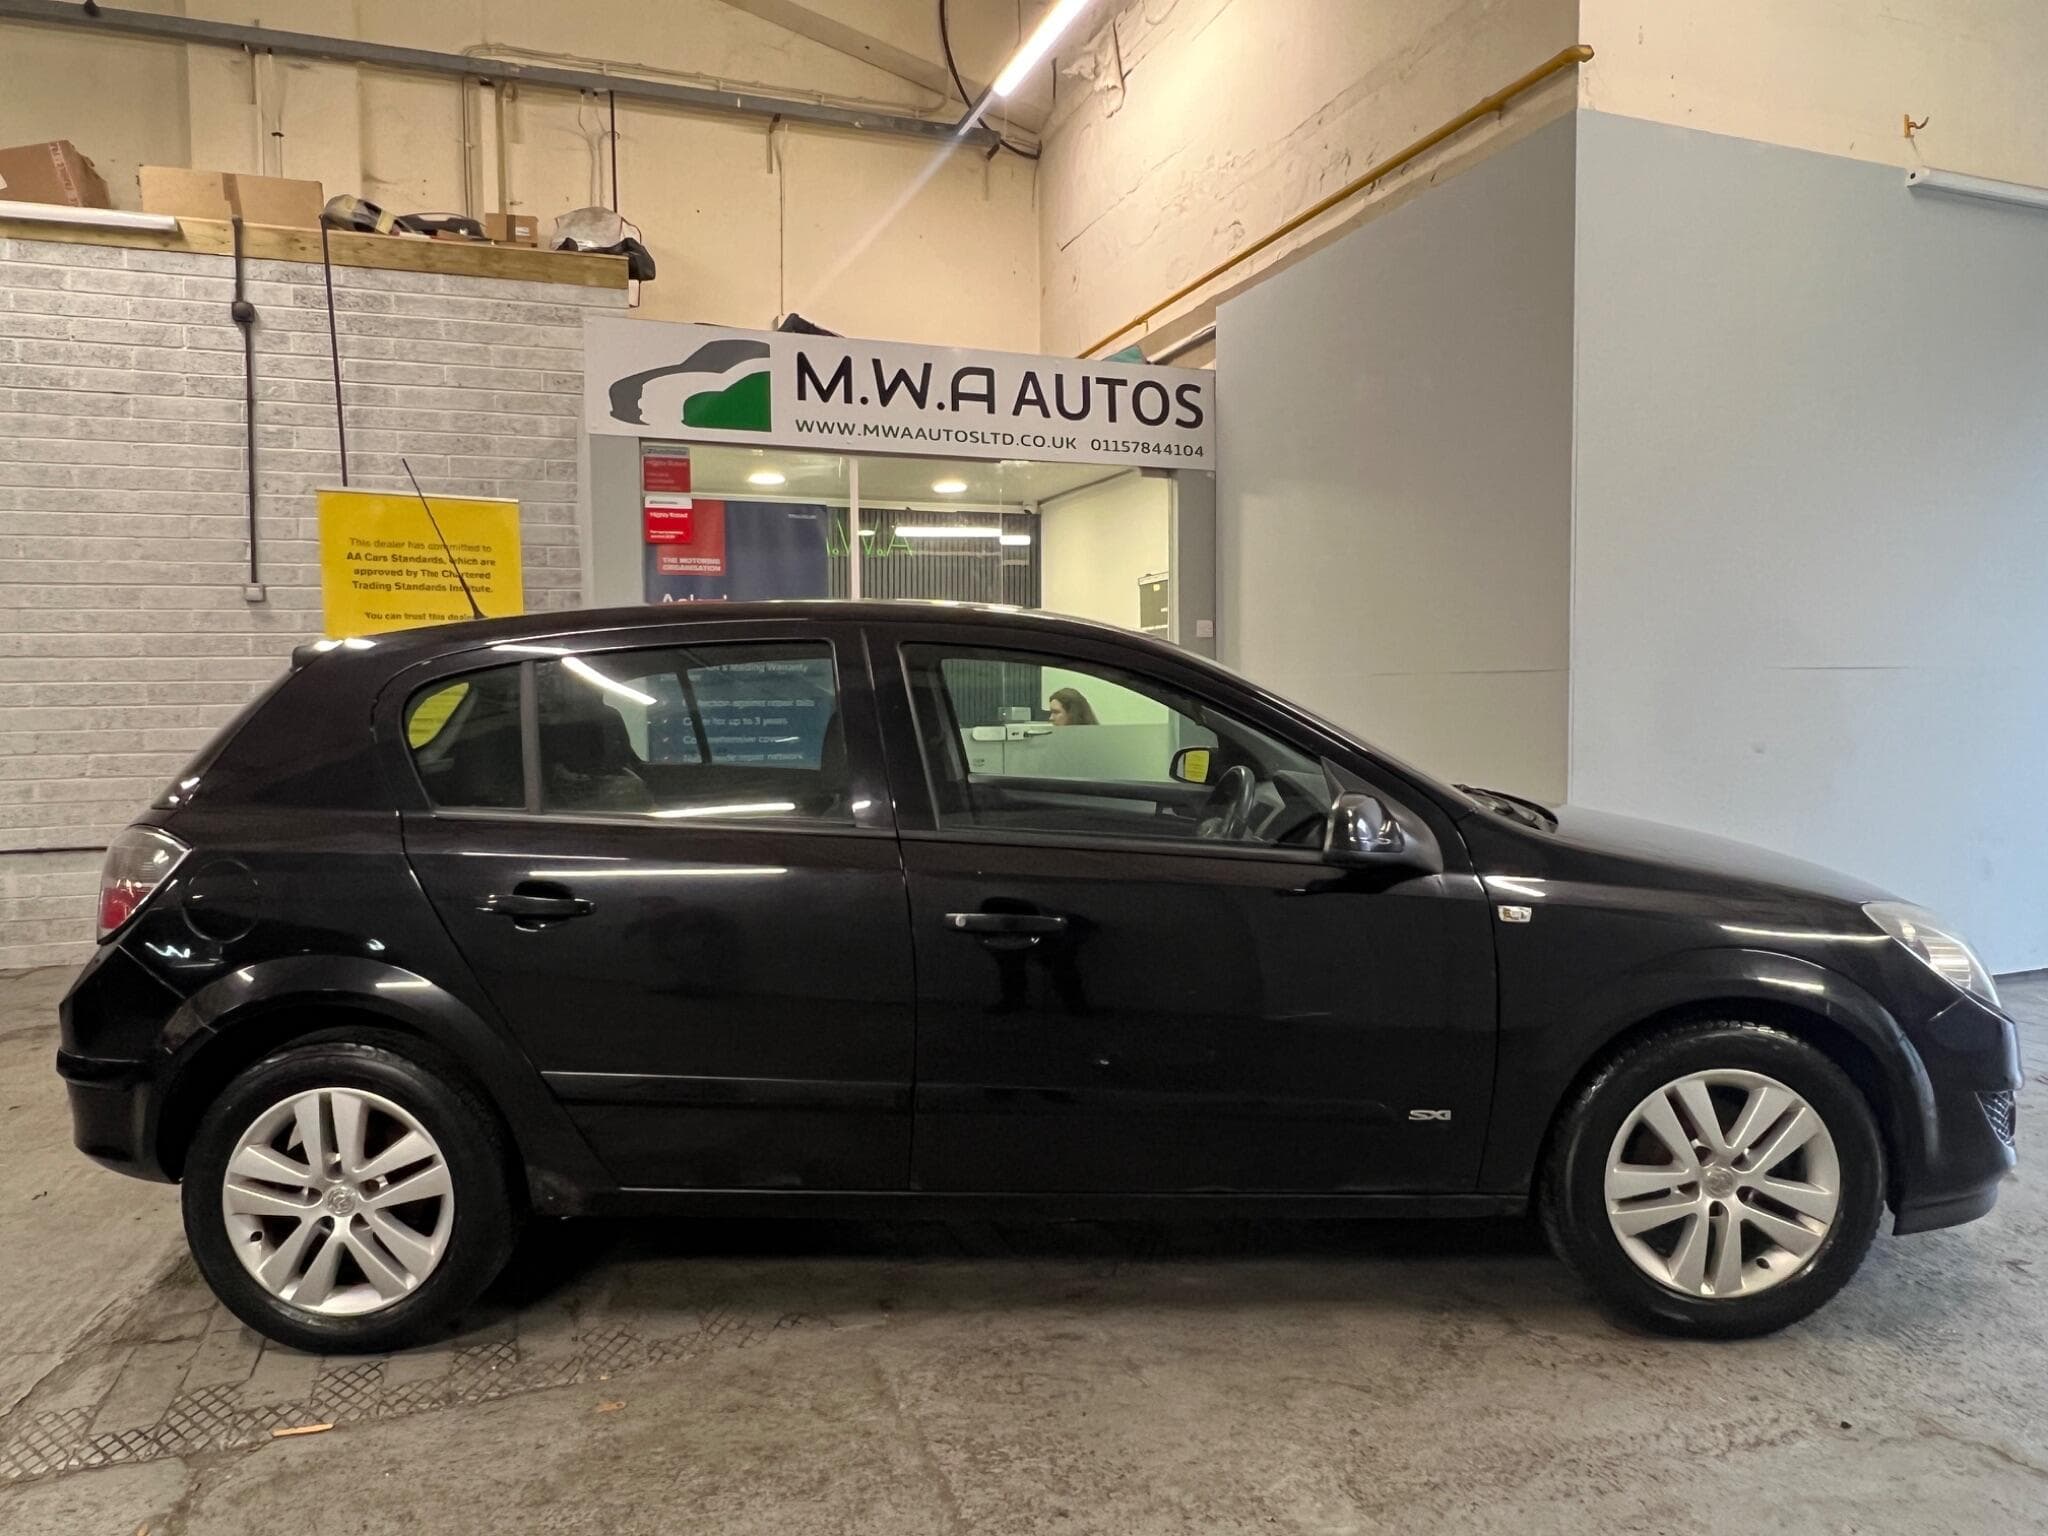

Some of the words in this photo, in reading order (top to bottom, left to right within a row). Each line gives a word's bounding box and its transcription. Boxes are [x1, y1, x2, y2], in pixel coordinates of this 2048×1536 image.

[797, 351, 995, 414] M.W.A
[1012, 371, 1204, 429] AUTOS
[795, 419, 1077, 449] WWW.MWAAUTOSLTD.CO.UK
[1091, 439, 1204, 457] 01157844104
[347, 552, 362, 560] AA
[365, 553, 388, 562] Cars
[353, 568, 404, 577] approved
[406, 569, 418, 578] by
[352, 581, 392, 591] Trading
[394, 582, 447, 592] Standards
[450, 584, 494, 592] Instute.
[364, 611, 383, 620] You
